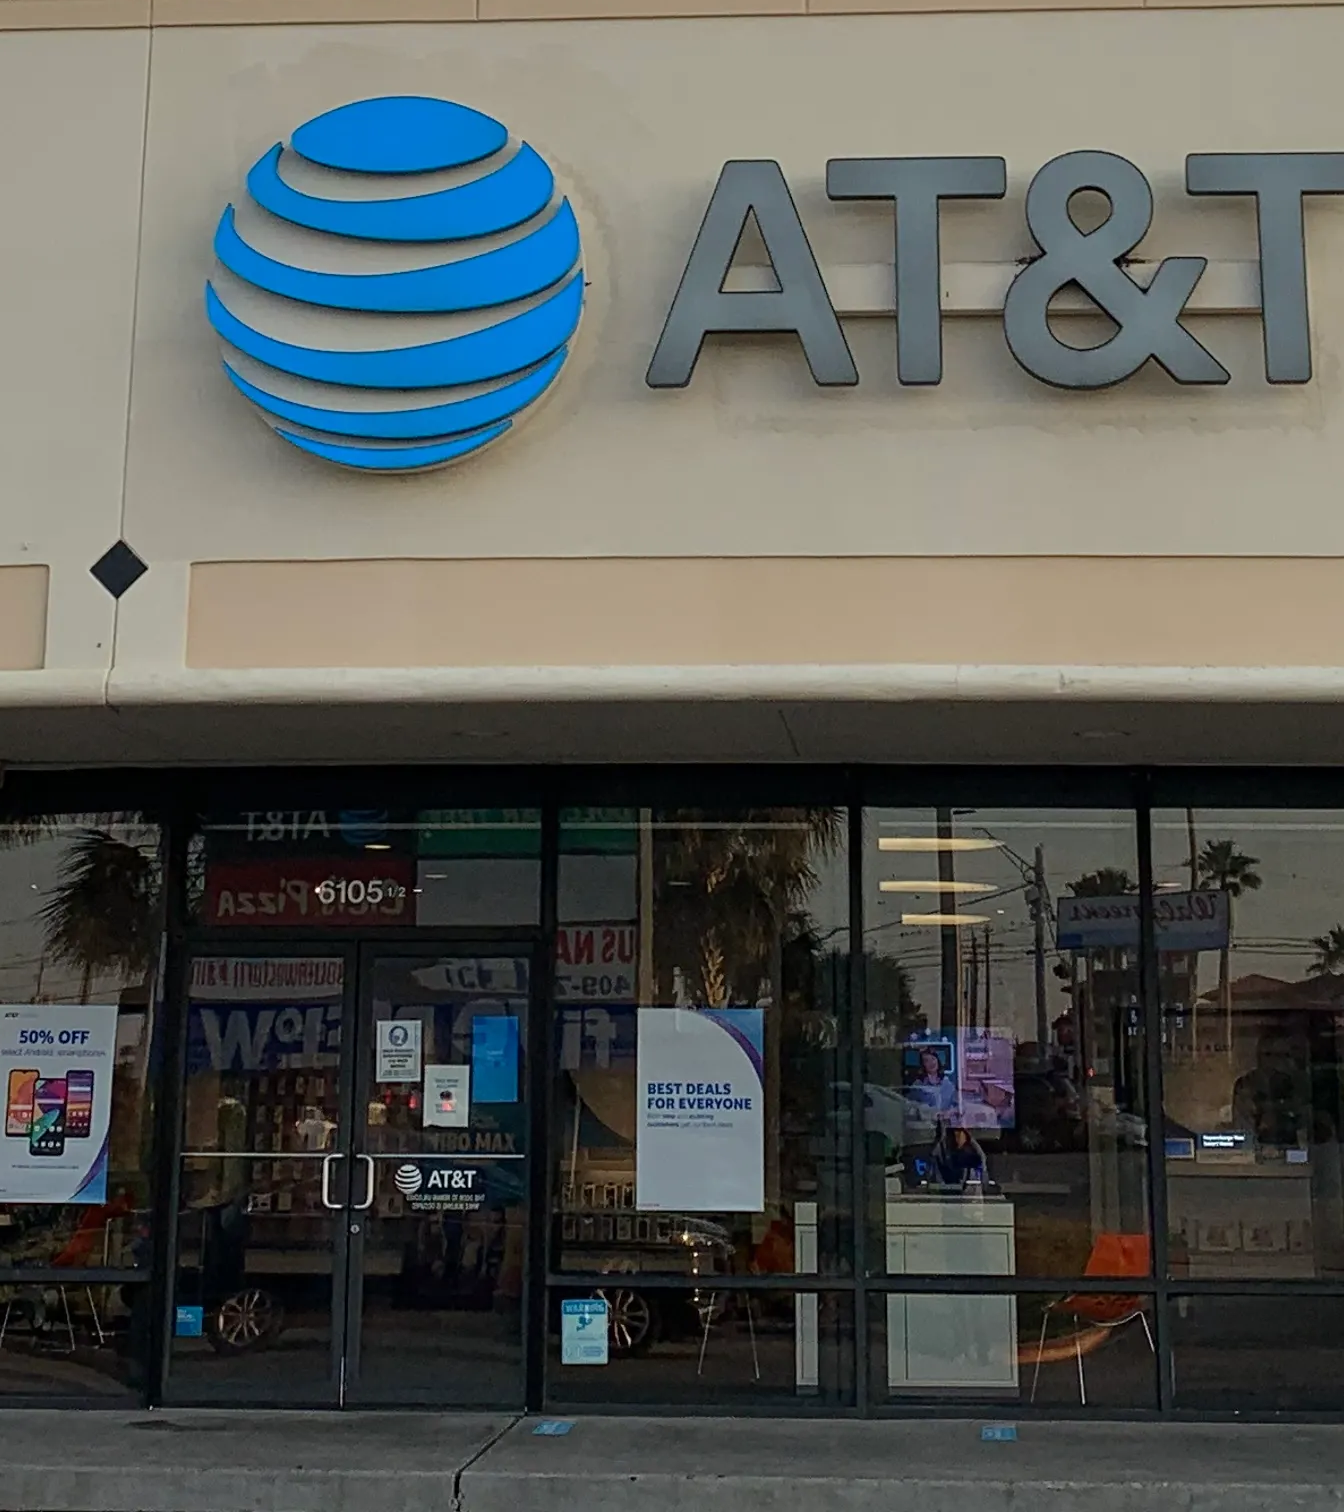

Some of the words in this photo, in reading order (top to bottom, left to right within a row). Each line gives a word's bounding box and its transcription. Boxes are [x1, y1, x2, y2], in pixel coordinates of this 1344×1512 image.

[318, 880, 383, 904] 6105
[387, 887, 406, 898] 1/2
[19, 1030, 54, 1045] 50%
[58, 1030, 90, 1045] OFF
[647, 1083, 682, 1095] BEST
[686, 1083, 731, 1095] DEALS
[647, 1098, 675, 1110] FOR
[679, 1098, 752, 1110] EVERYONE
[427, 1170, 477, 1189] AT&T
